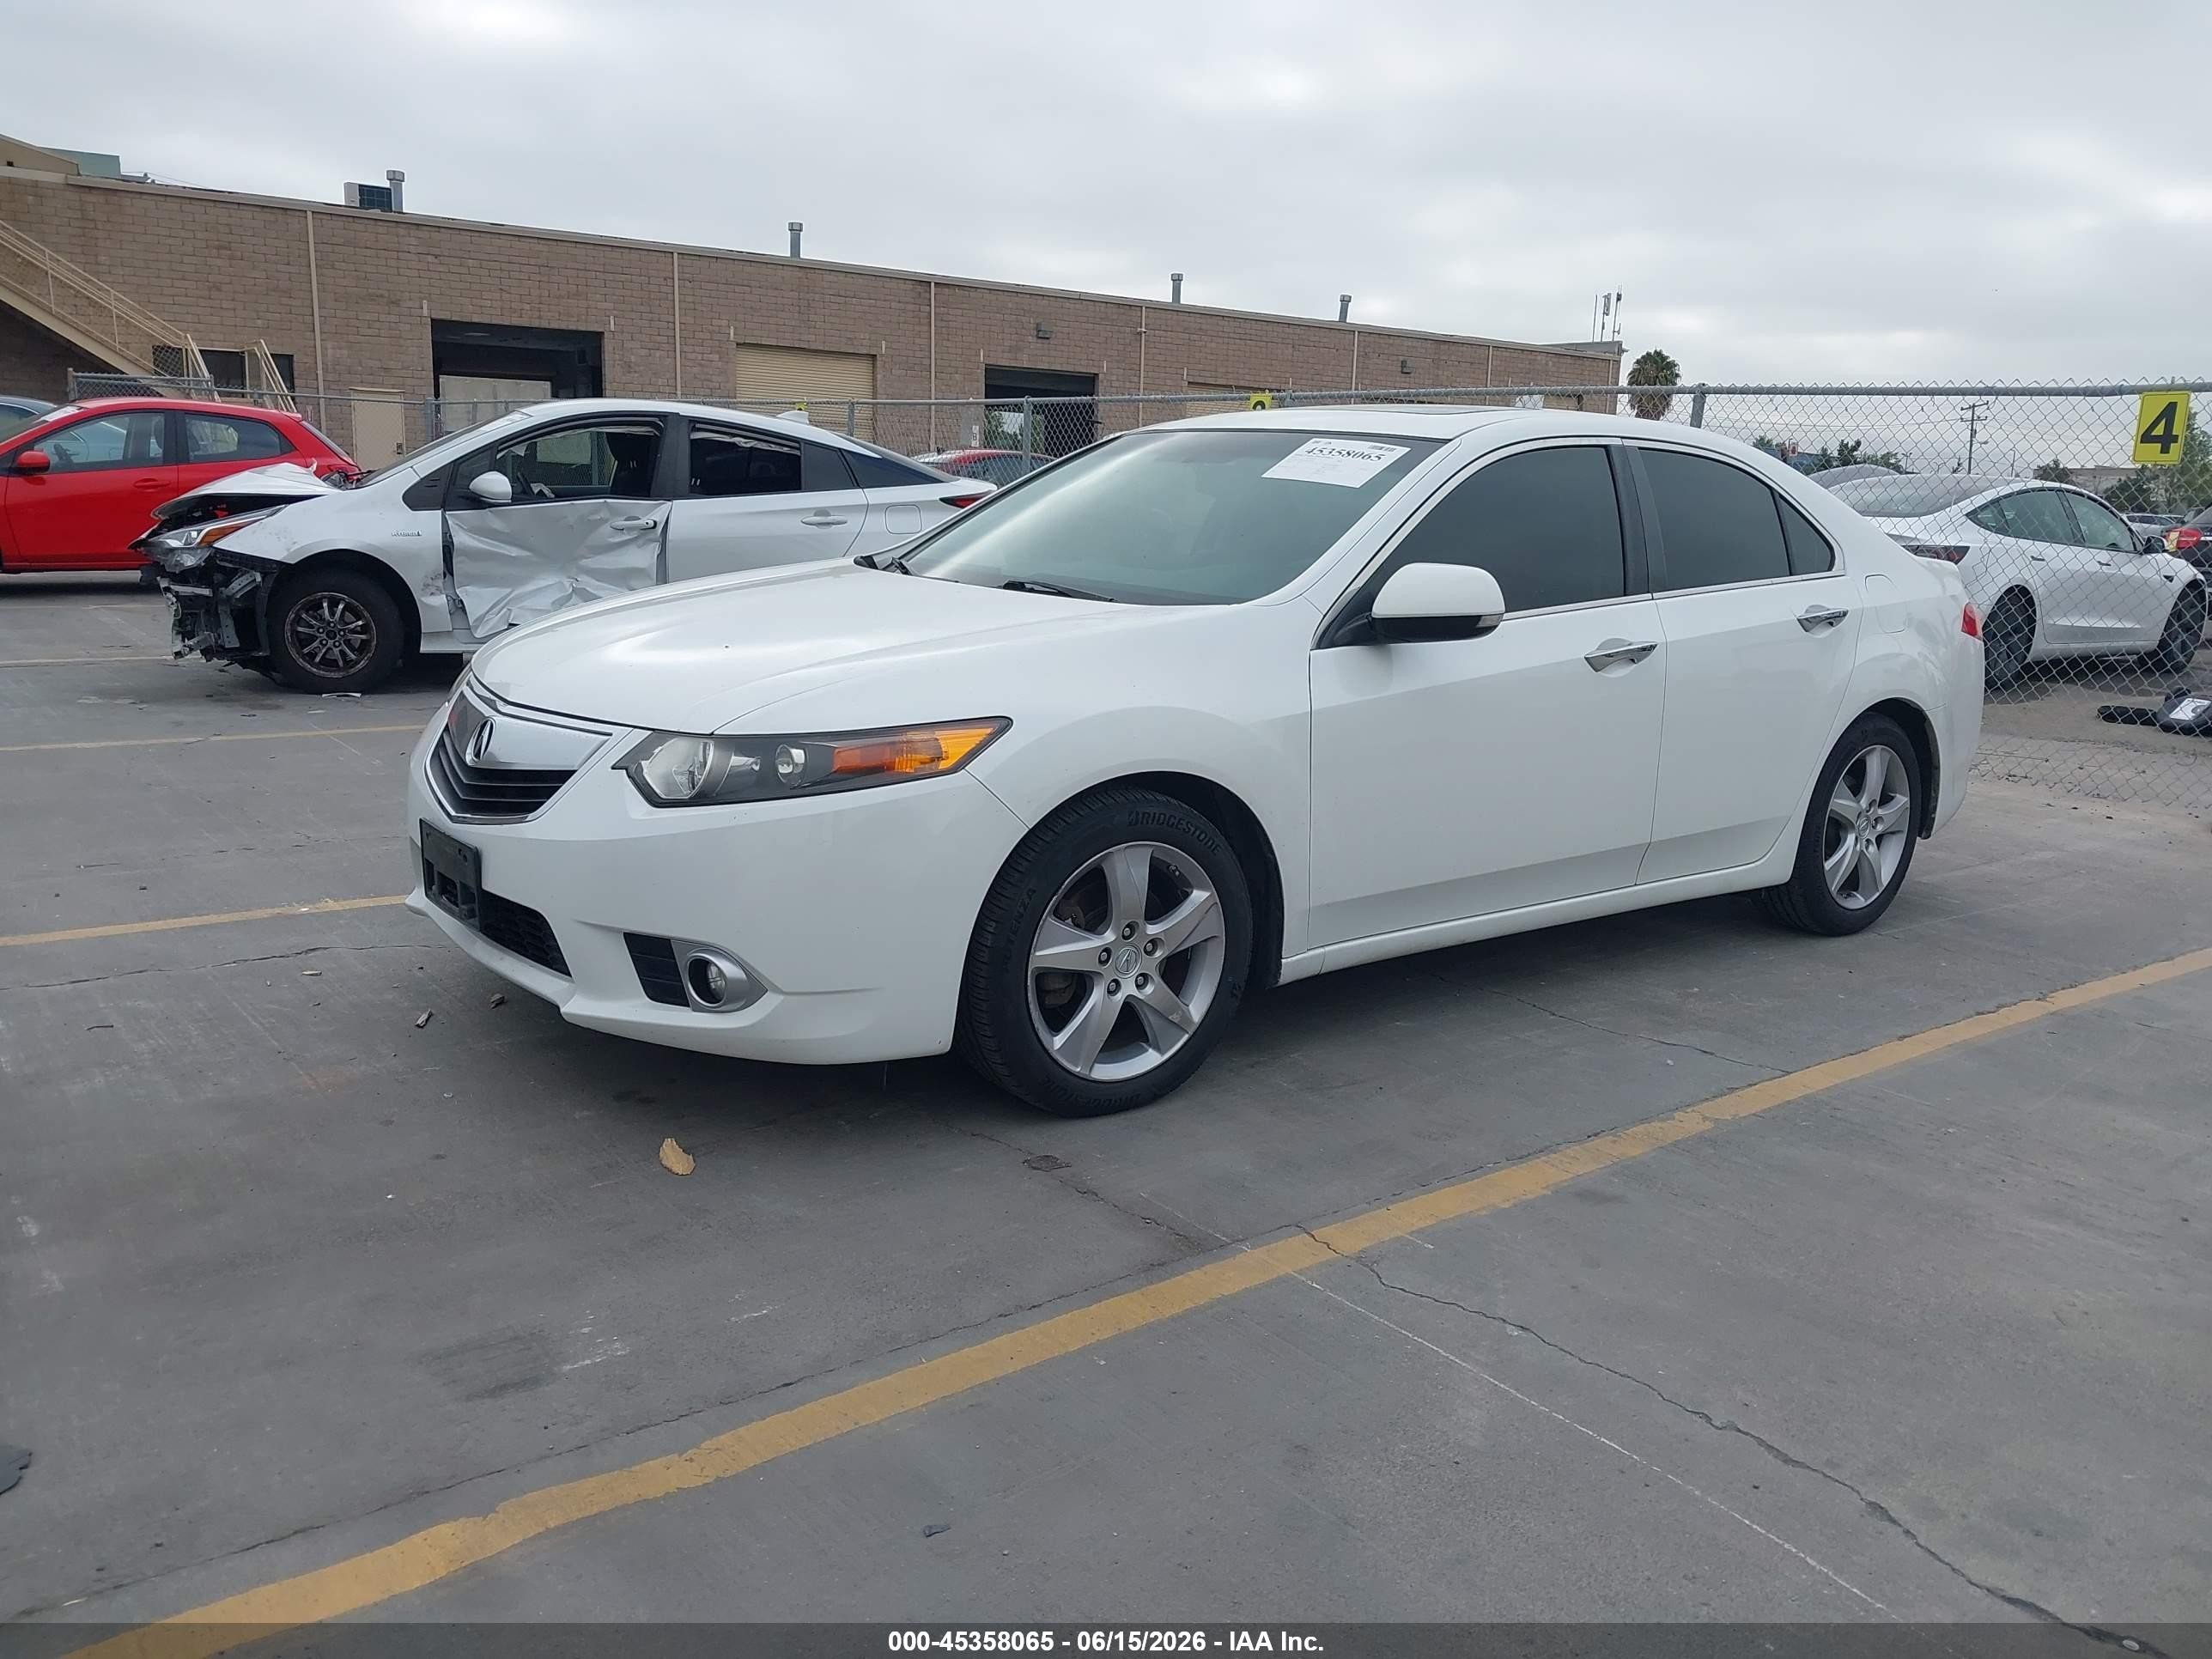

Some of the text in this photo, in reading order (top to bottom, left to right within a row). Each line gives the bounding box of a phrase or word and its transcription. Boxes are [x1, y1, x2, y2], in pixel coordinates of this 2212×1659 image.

[2140, 401, 2179, 454] 4
[1305, 447, 1386, 462] 45358065
[1127, 810, 1222, 855] BRIDGESTONE
